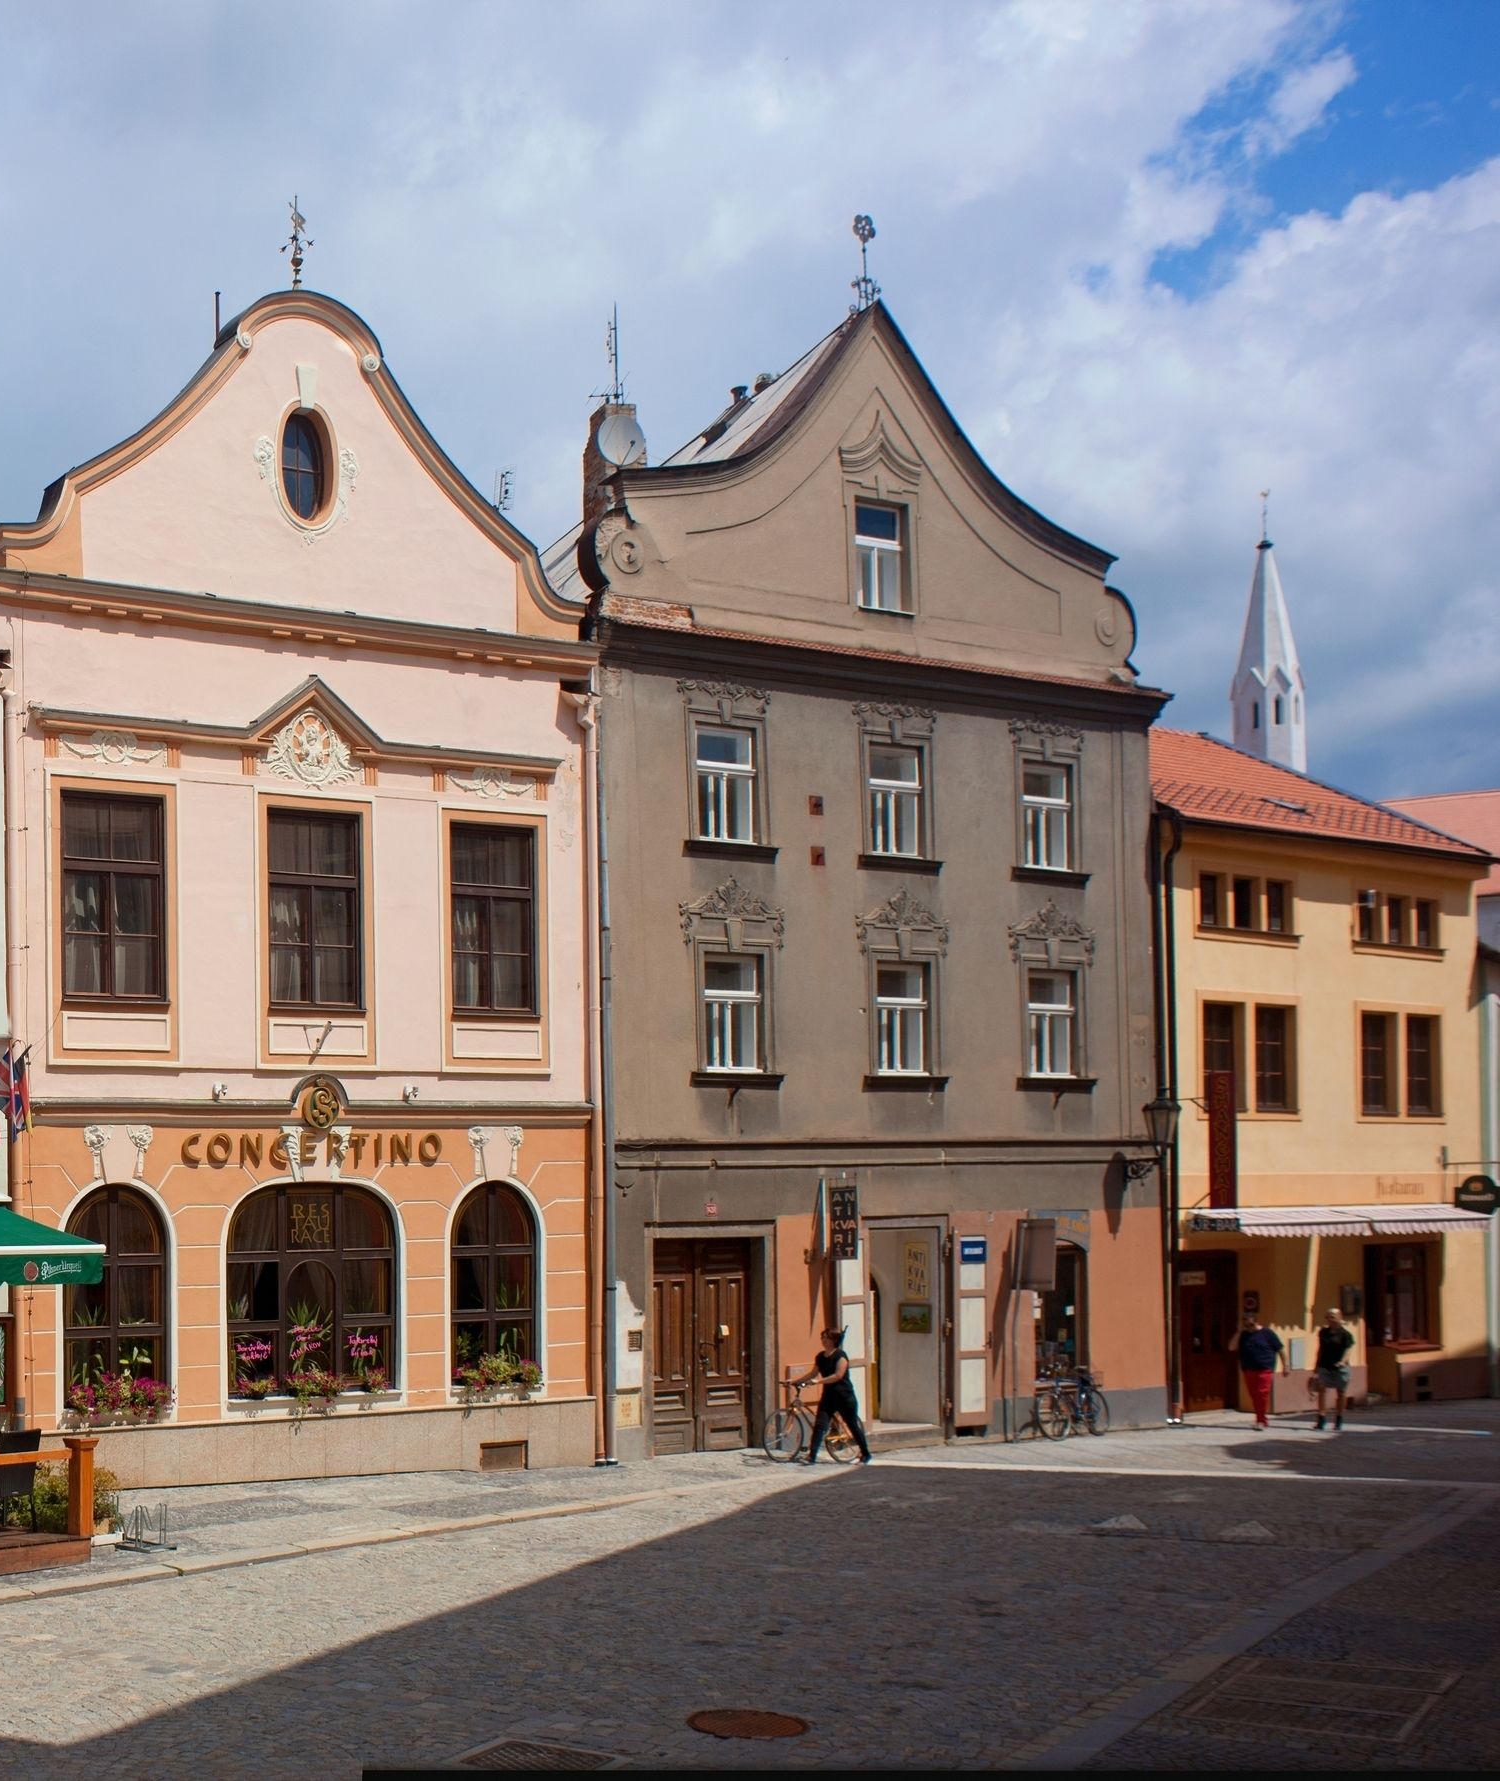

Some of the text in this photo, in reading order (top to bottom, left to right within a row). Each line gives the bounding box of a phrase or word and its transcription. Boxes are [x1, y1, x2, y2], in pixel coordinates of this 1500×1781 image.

[181, 1131, 443, 1163] CONCERTINO
[41, 1259, 82, 1281] Pilsner Urquell
